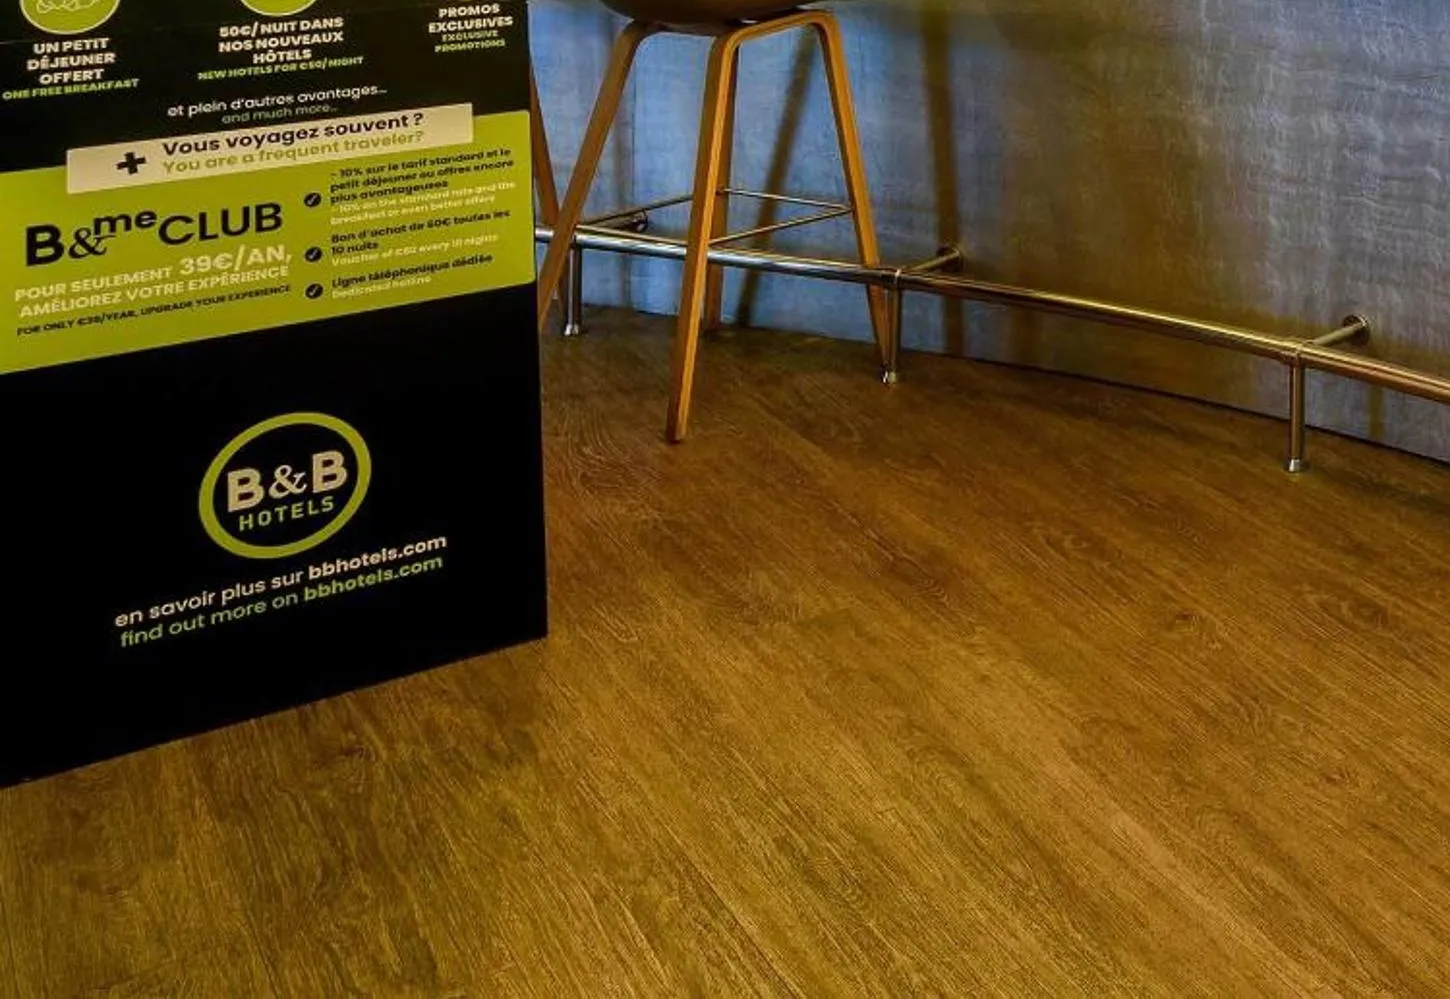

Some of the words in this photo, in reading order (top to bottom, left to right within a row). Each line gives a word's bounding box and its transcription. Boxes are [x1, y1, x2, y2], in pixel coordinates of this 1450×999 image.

[438, 3, 501, 18] PROMOS
[300, 16, 344, 31] DANS
[428, 16, 514, 33] EXCLUSIVES
[218, 39, 253, 53] NOS
[255, 31, 344, 50] NOUVEAUX
[442, 29, 499, 42] EXCLUSIVE
[33, 42, 59, 54] UN
[62, 37, 110, 52] PETIT
[434, 38, 506, 53] PROMOTIONS
[253, 49, 313, 64] HÔTELS
[39, 68, 105, 85] OFFERT
[198, 69, 228, 80] NEW
[228, 64, 273, 78] HOTELS
[274, 63, 298, 73] FOR
[2, 88, 30, 100] ONE
[32, 85, 62, 98] FREE
[64, 78, 140, 95] BREAKFAST
[167, 104, 184, 117] et
[188, 100, 227, 119] plein
[230, 94, 294, 110] d'autres
[221, 113, 250, 125] and
[253, 108, 293, 122] much
[163, 138, 220, 156] Vous
[225, 129, 319, 150] voyagez
[324, 116, 409, 137] souvent
[414, 113, 424, 126] ?
[163, 159, 200, 174] You
[204, 155, 238, 169] are
[241, 154, 254, 165] a
[257, 142, 339, 163] frequent
[342, 130, 425, 151] traveler?
[428, 152, 484, 166] standard
[330, 179, 359, 193] petit
[14, 282, 67, 302] POUR
[71, 266, 173, 294] SEULEMENT
[19, 293, 123, 318] AMÉLIOREZ
[124, 280, 184, 302] VOTRE
[188, 265, 289, 292] EXPÉRIENCE
[17, 324, 41, 336] FOR
[43, 319, 76, 333] ONLY
[140, 301, 194, 316] UPGRADE
[195, 294, 226, 308] YOUR
[228, 284, 292, 302] EXPERIENCE
[226, 450, 348, 513] B&B
[238, 495, 336, 531] HOTELS
[114, 609, 142, 627] en
[149, 590, 215, 620] savoir
[221, 577, 266, 607] plus
[271, 569, 304, 590] sur
[308, 533, 448, 581] bbhotels.com
[120, 622, 163, 648] find
[169, 612, 205, 636] out
[210, 600, 267, 625] more
[271, 591, 299, 609] on
[304, 554, 443, 602] bbhotels.com
